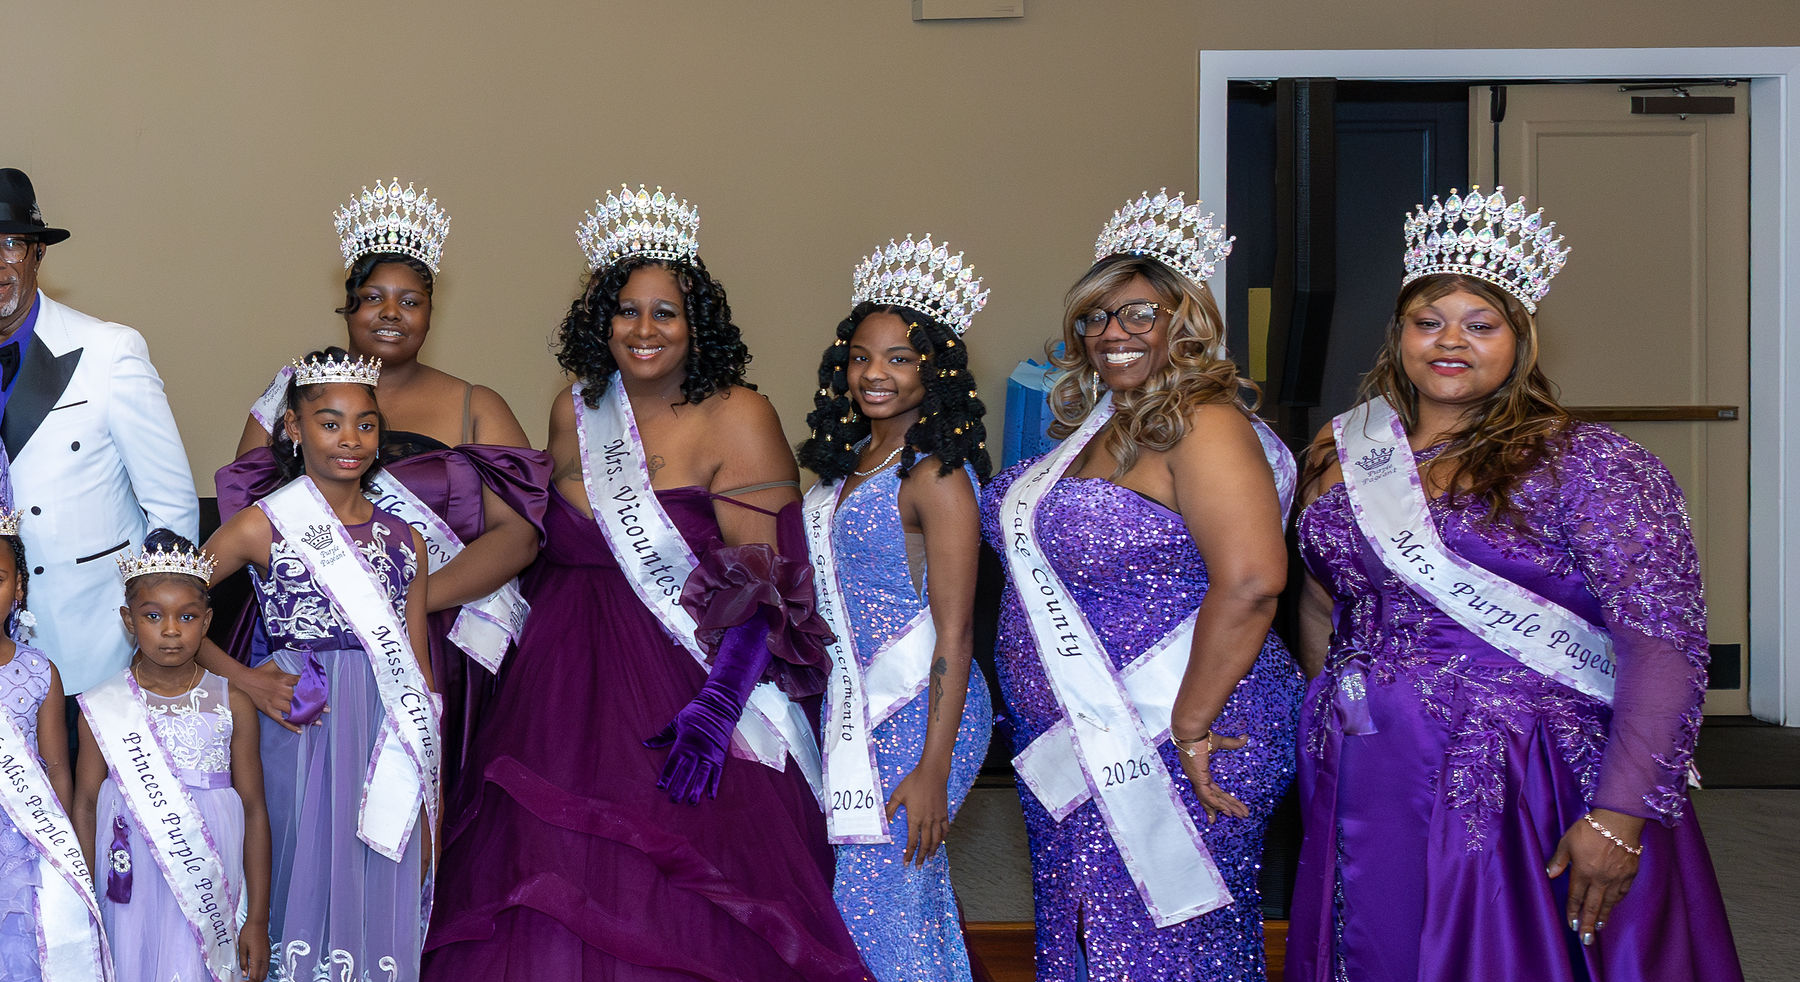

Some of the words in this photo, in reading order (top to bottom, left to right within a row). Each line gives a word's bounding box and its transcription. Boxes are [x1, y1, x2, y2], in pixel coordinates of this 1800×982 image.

[603, 438, 631, 482] Mrs.
[811, 510, 823, 545] Ms.
[816, 554, 836, 625] Greater
[1014, 500, 1031, 558] Lake
[1031, 568, 1083, 658] County
[1390, 529, 1435, 581] Mrs.
[1449, 582, 1542, 638] Purple
[371, 625, 405, 684] Miss.
[400, 692, 435, 759] Citrus
[832, 789, 874, 811] 2026
[1102, 755, 1150, 788] 2026
[25, 795, 68, 847] Purple
[123, 732, 167, 808] Princess
[161, 812, 206, 875] Purple
[195, 877, 234, 947] Pageant
